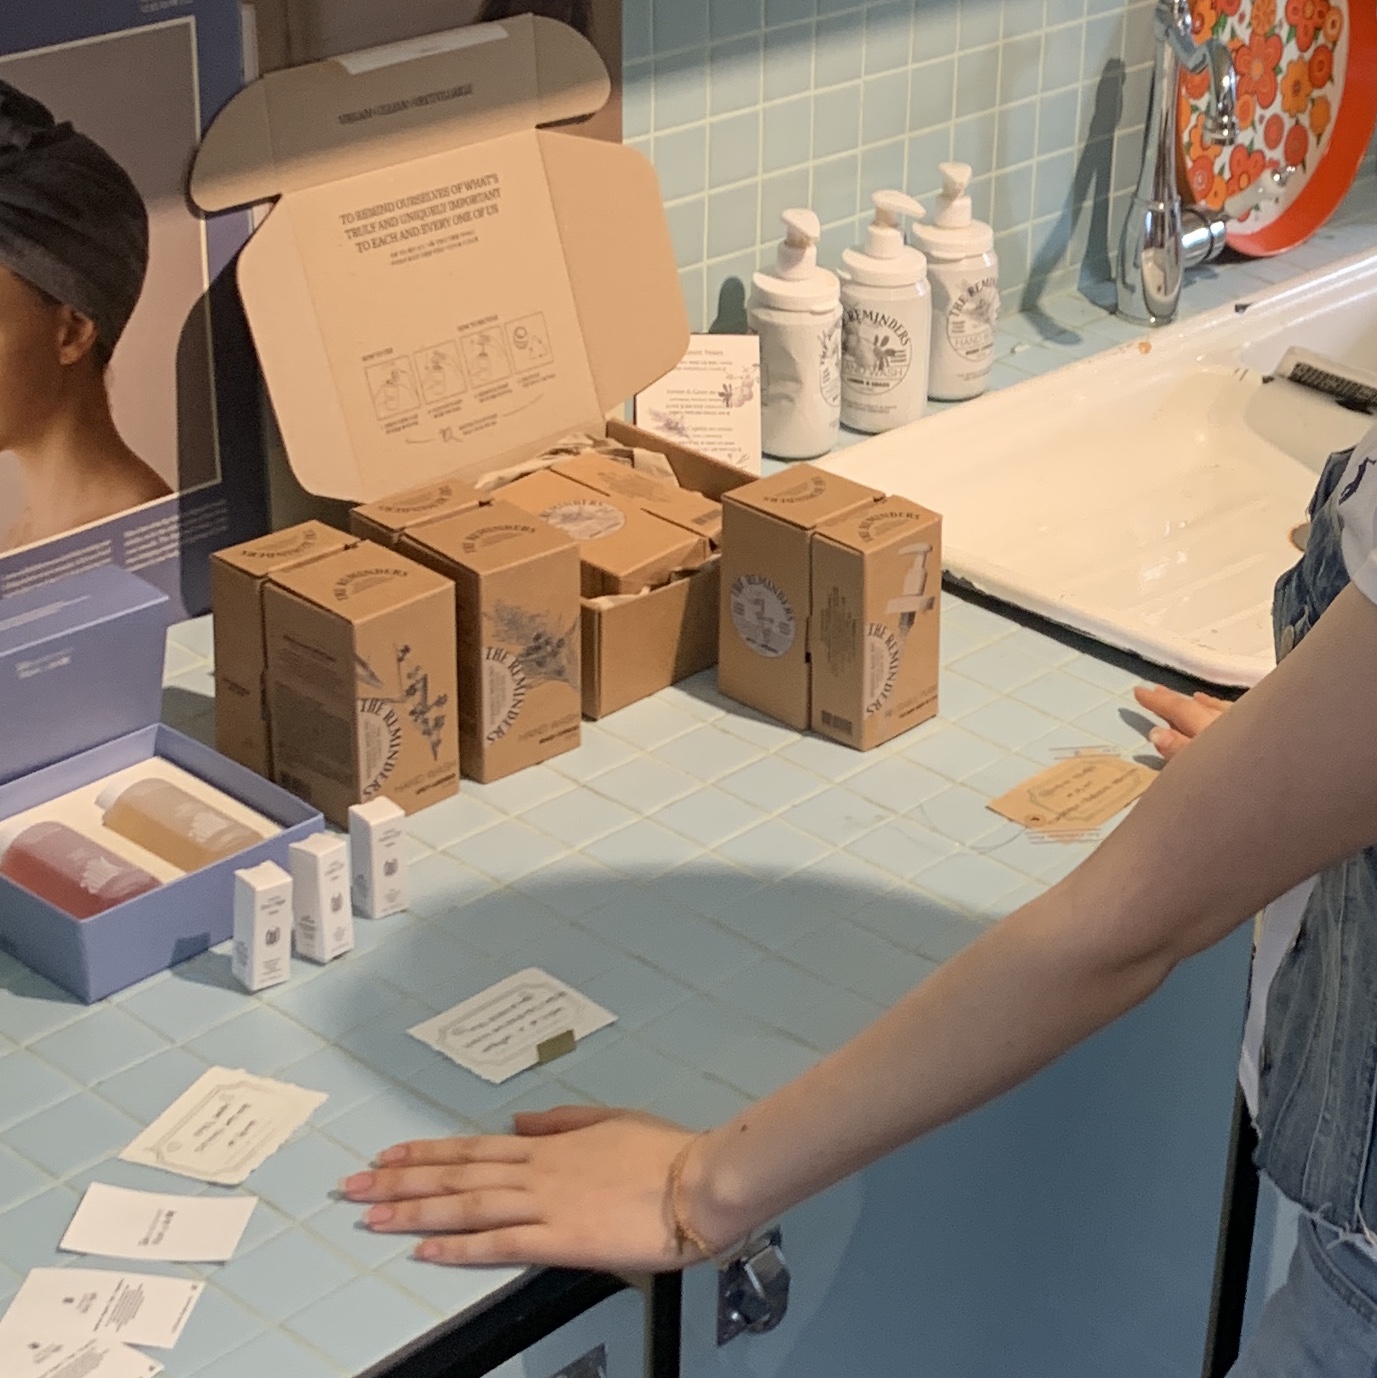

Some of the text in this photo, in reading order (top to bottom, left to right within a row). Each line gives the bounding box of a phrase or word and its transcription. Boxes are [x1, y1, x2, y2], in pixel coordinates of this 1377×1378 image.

[396, 186, 451, 211] OURSELVES
[451, 182, 463, 195] OF
[449, 187, 501, 212] IMPORTANT
[485, 646, 526, 744] THE REMINDERS
[866, 623, 900, 716] THE REMINDERS
[360, 698, 384, 716] THE
[363, 709, 402, 795] REMINDERS
